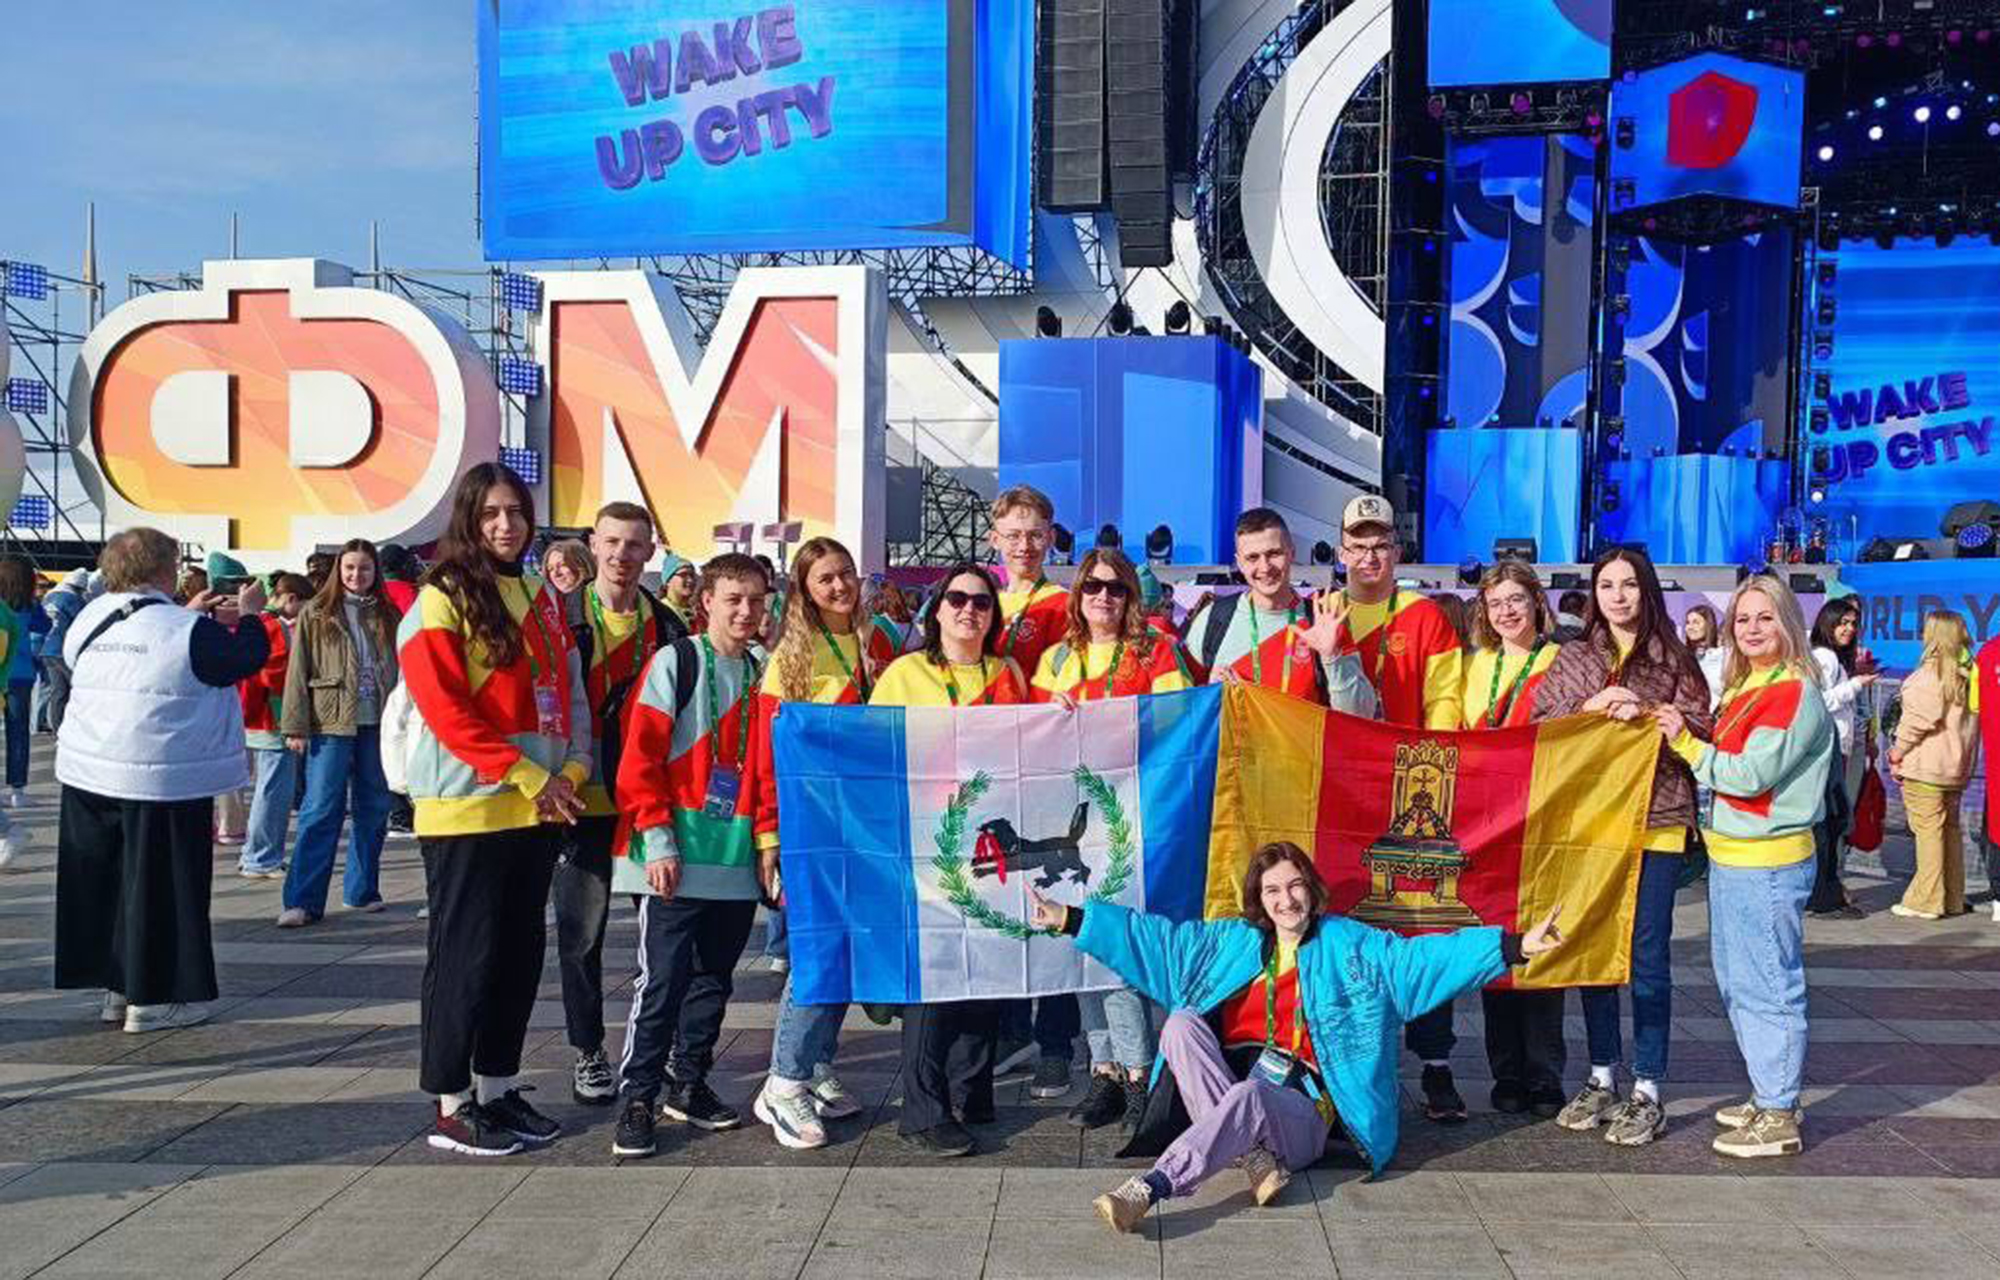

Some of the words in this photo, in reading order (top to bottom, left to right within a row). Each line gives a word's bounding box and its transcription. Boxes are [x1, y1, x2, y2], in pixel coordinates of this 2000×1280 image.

[608, 4, 803, 107] WAKE
[594, 119, 684, 190] UP
[693, 76, 835, 166] CITY
[0, 258, 886, 568] ФМ
[1823, 441, 1879, 484] UP
[1886, 417, 1995, 470] CITY
[1827, 372, 1969, 431] WAKE
